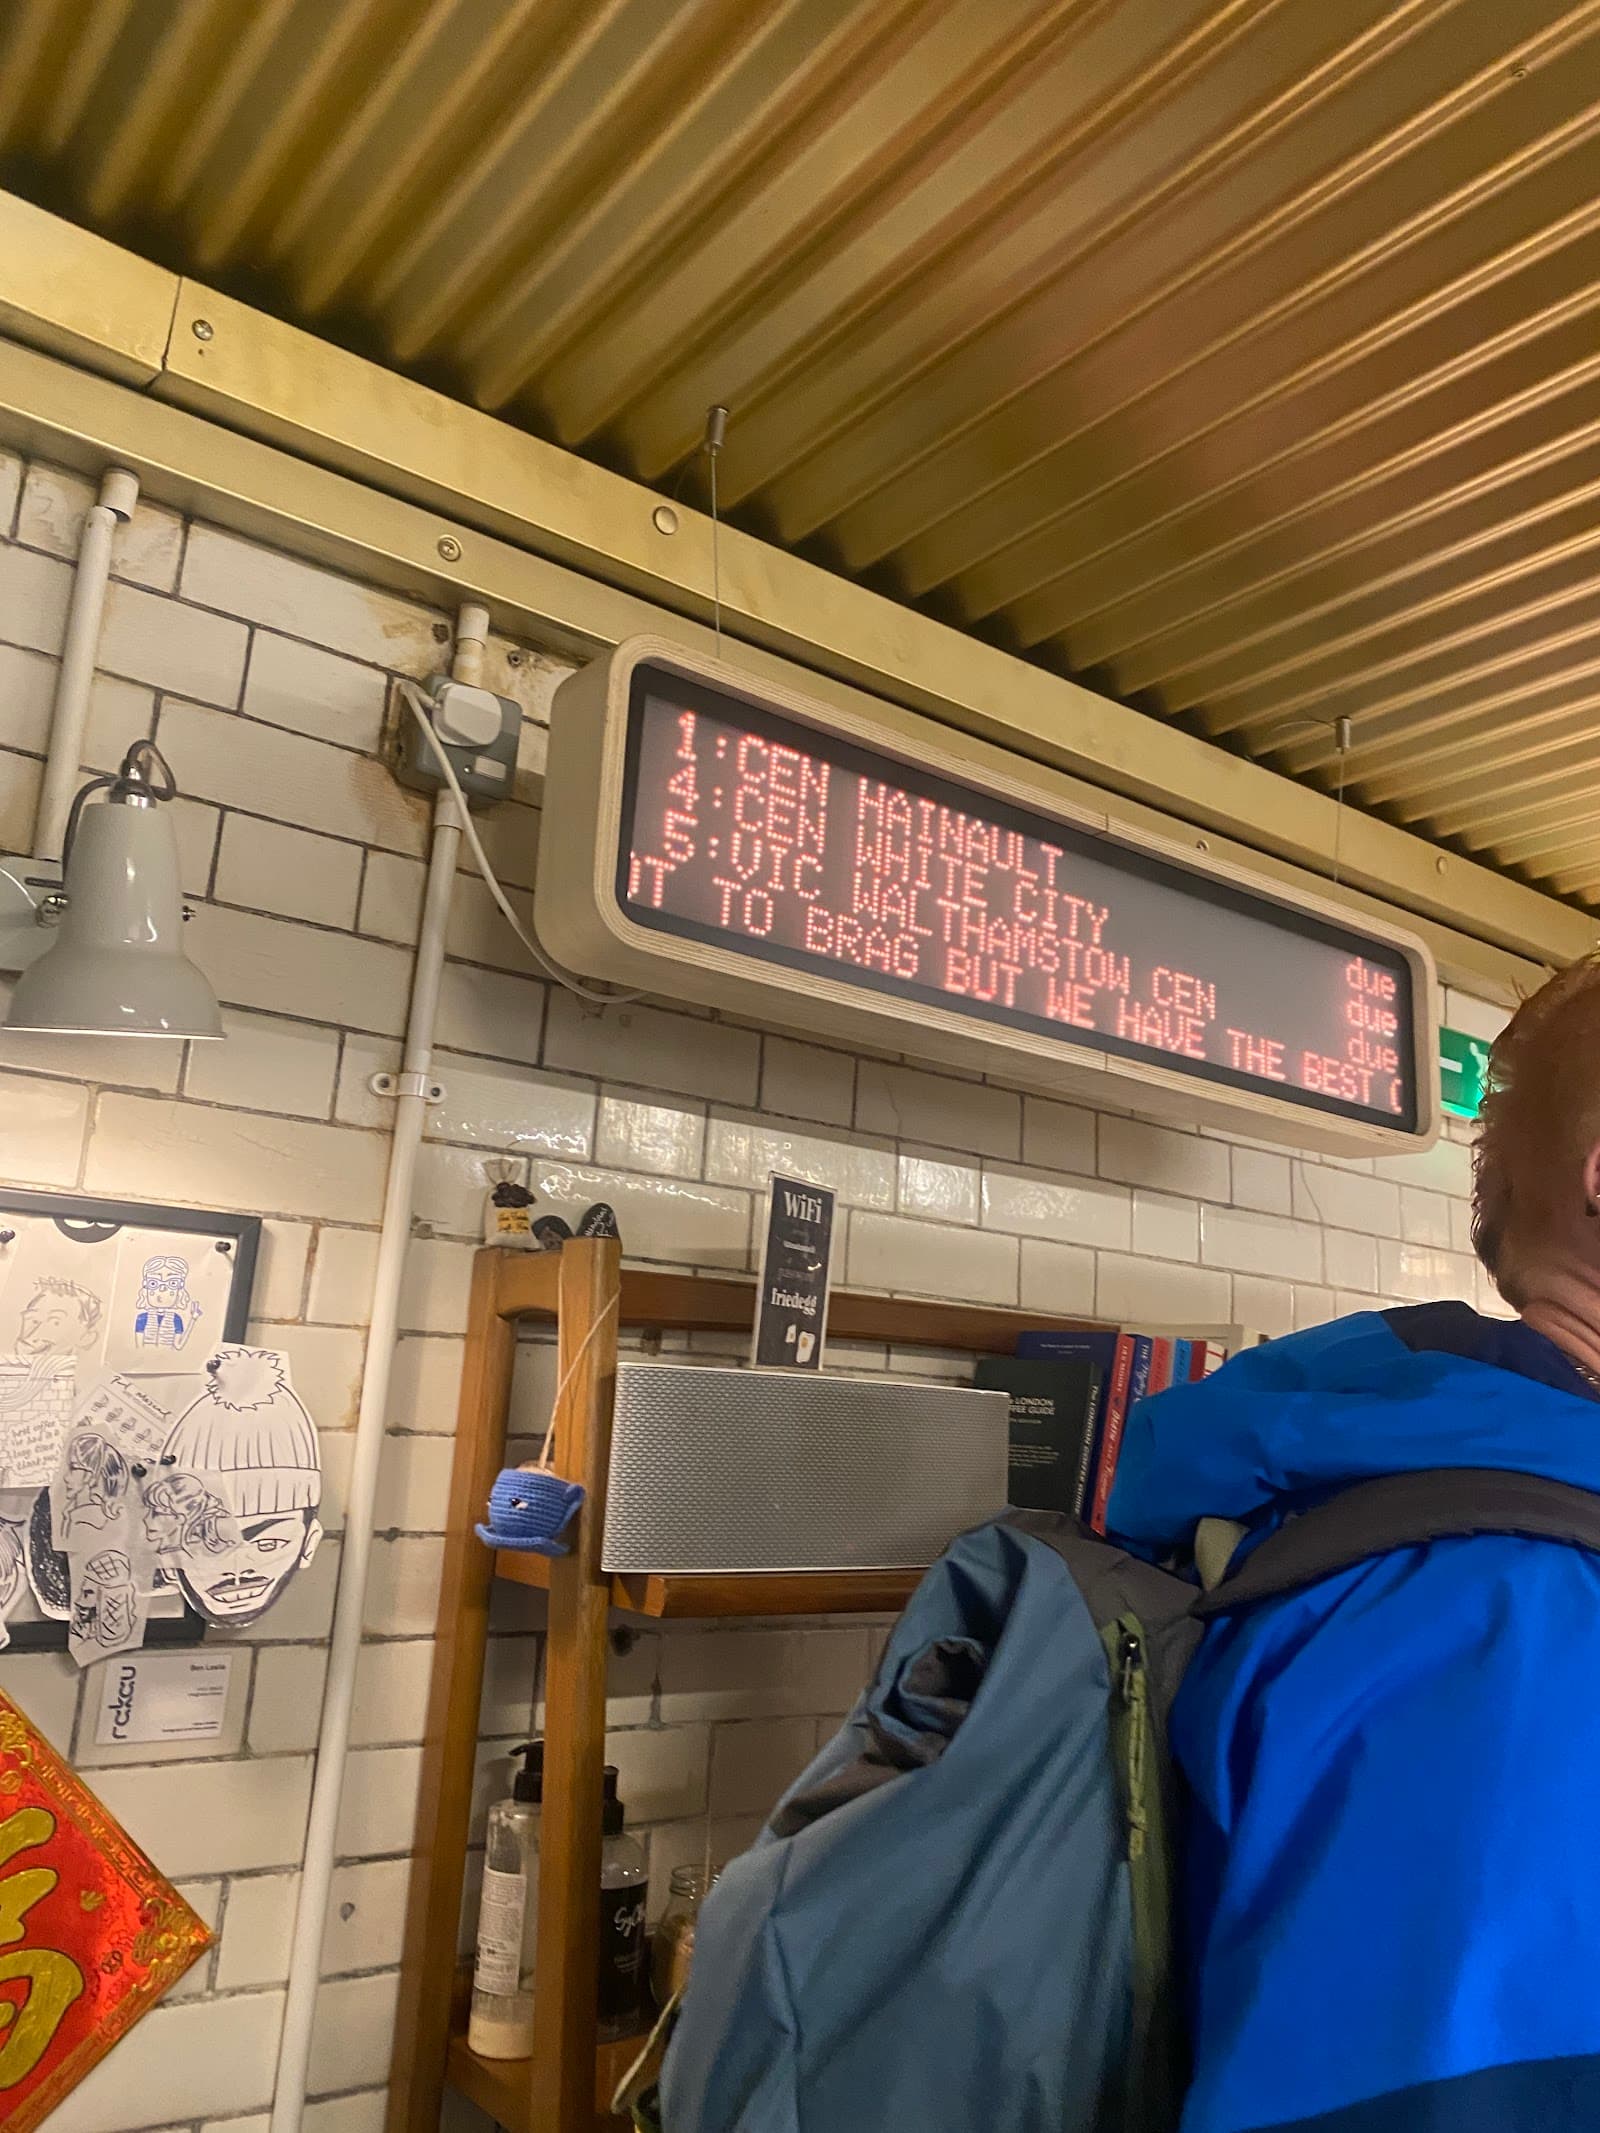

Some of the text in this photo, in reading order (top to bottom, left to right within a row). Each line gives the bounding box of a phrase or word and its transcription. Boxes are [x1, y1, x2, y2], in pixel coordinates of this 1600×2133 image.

[855, 824, 989, 908] WHITE
[1013, 879, 1109, 945] CITY
[1345, 994, 1398, 1037] due
[858, 776, 1064, 887] HAINAULT
[1345, 957, 1397, 1002] due
[713, 876, 774, 936] TO
[806, 906, 919, 979] BRAG
[944, 947, 1023, 1008] BUT
[1046, 975, 1096, 1030] WE
[1117, 997, 1206, 1060] HAVE
[1227, 1028, 1286, 1081] THE
[1302, 1051, 1374, 1104] BEST
[853, 871, 1131, 996] WALTHAMSTOW
[1151, 966, 1216, 1020] CEN
[1347, 1031, 1399, 1073] due
[783, 1191, 823, 1225] WiFi
[770, 1287, 817, 1316] friedegg
[1015, 1396, 1054, 1407] LONDON
[1028, 1404, 1055, 1415] GUIDE
